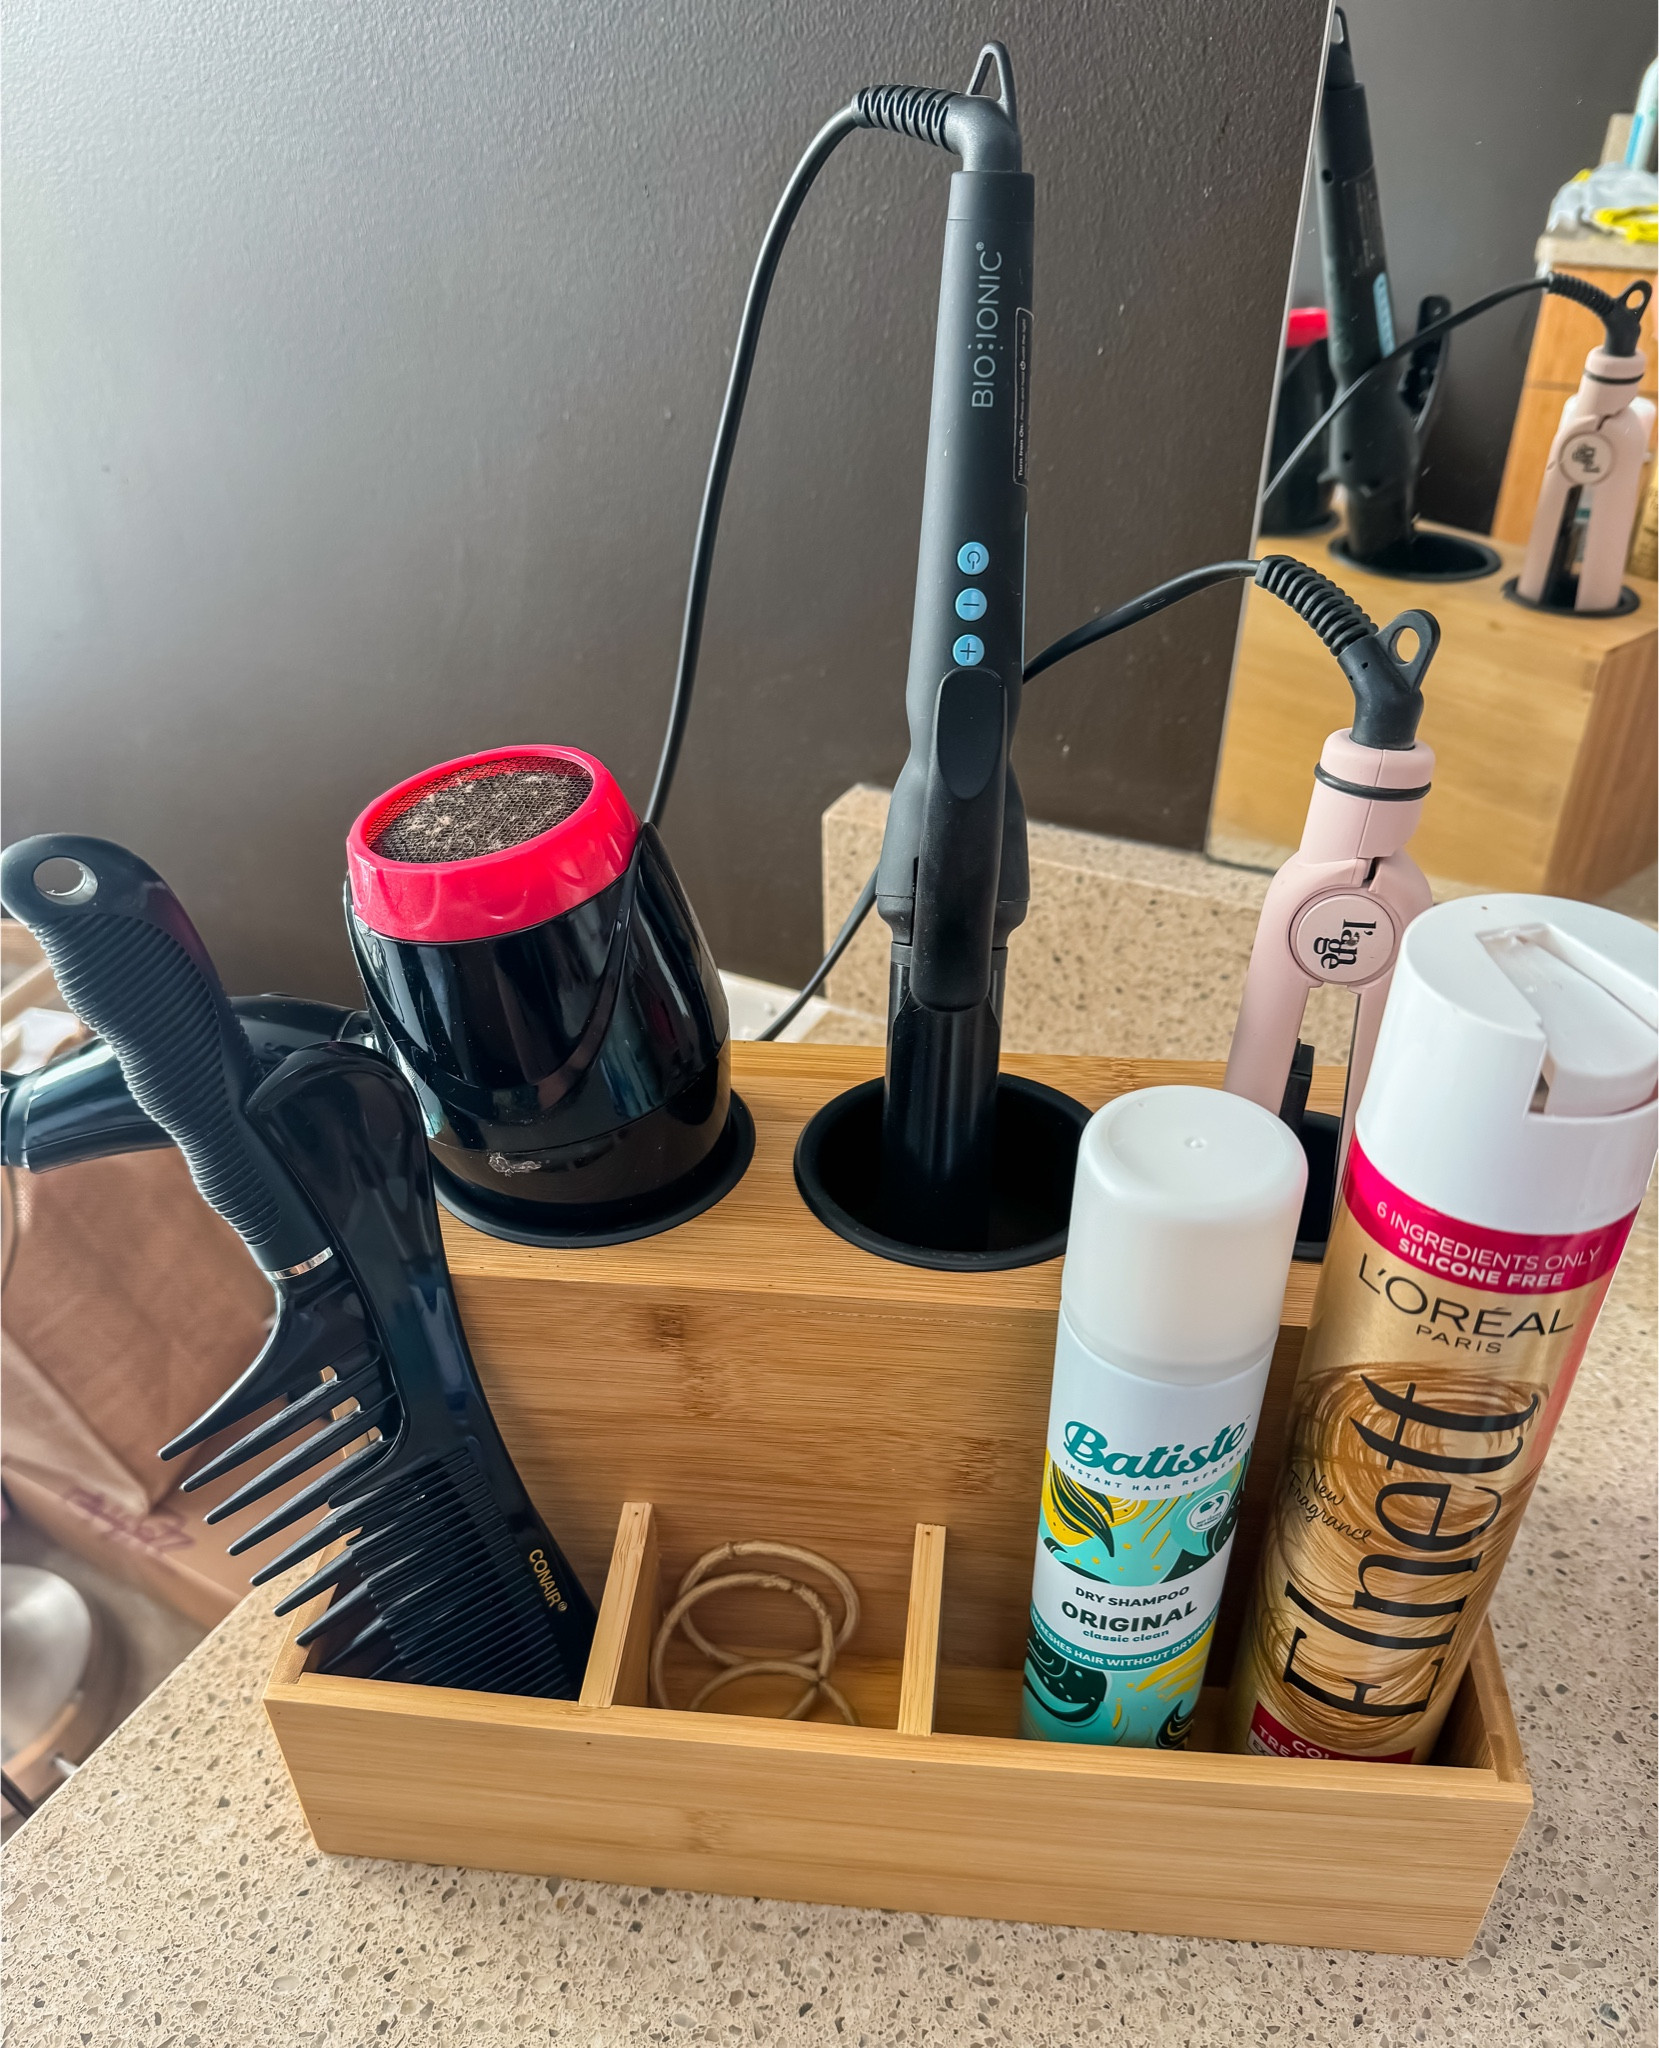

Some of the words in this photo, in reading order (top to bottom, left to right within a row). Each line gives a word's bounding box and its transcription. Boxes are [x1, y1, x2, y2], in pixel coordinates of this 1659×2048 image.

[1376, 1200, 1389, 1220] 6
[1389, 1210, 1538, 1272] INGREDIENTS
[1544, 1245, 1602, 1271] ONLY
[1398, 1237, 1502, 1285] SILICONE
[1506, 1271, 1565, 1288] FREE
[1415, 1323, 1502, 1354] PARIS
[1063, 1420, 1248, 1480] Batiste
[1064, 1459, 1123, 1489] INSTANT
[1131, 1482, 1172, 1492] HAIR
[1305, 1466, 1346, 1506] New
[1287, 1468, 1373, 1545] Fragrance
[1283, 1373, 1539, 1718] Elnett
[1075, 1586, 1106, 1604] DRY
[1107, 1585, 1190, 1607] SHAMPOO
[1061, 1600, 1198, 1632] ORIGINAL
[1082, 1629, 1130, 1643] classic
[1132, 1629, 1170, 1643] clean
[1073, 1649, 1105, 1666] HAIR
[1106, 1649, 1170, 1667] WITHOUT
